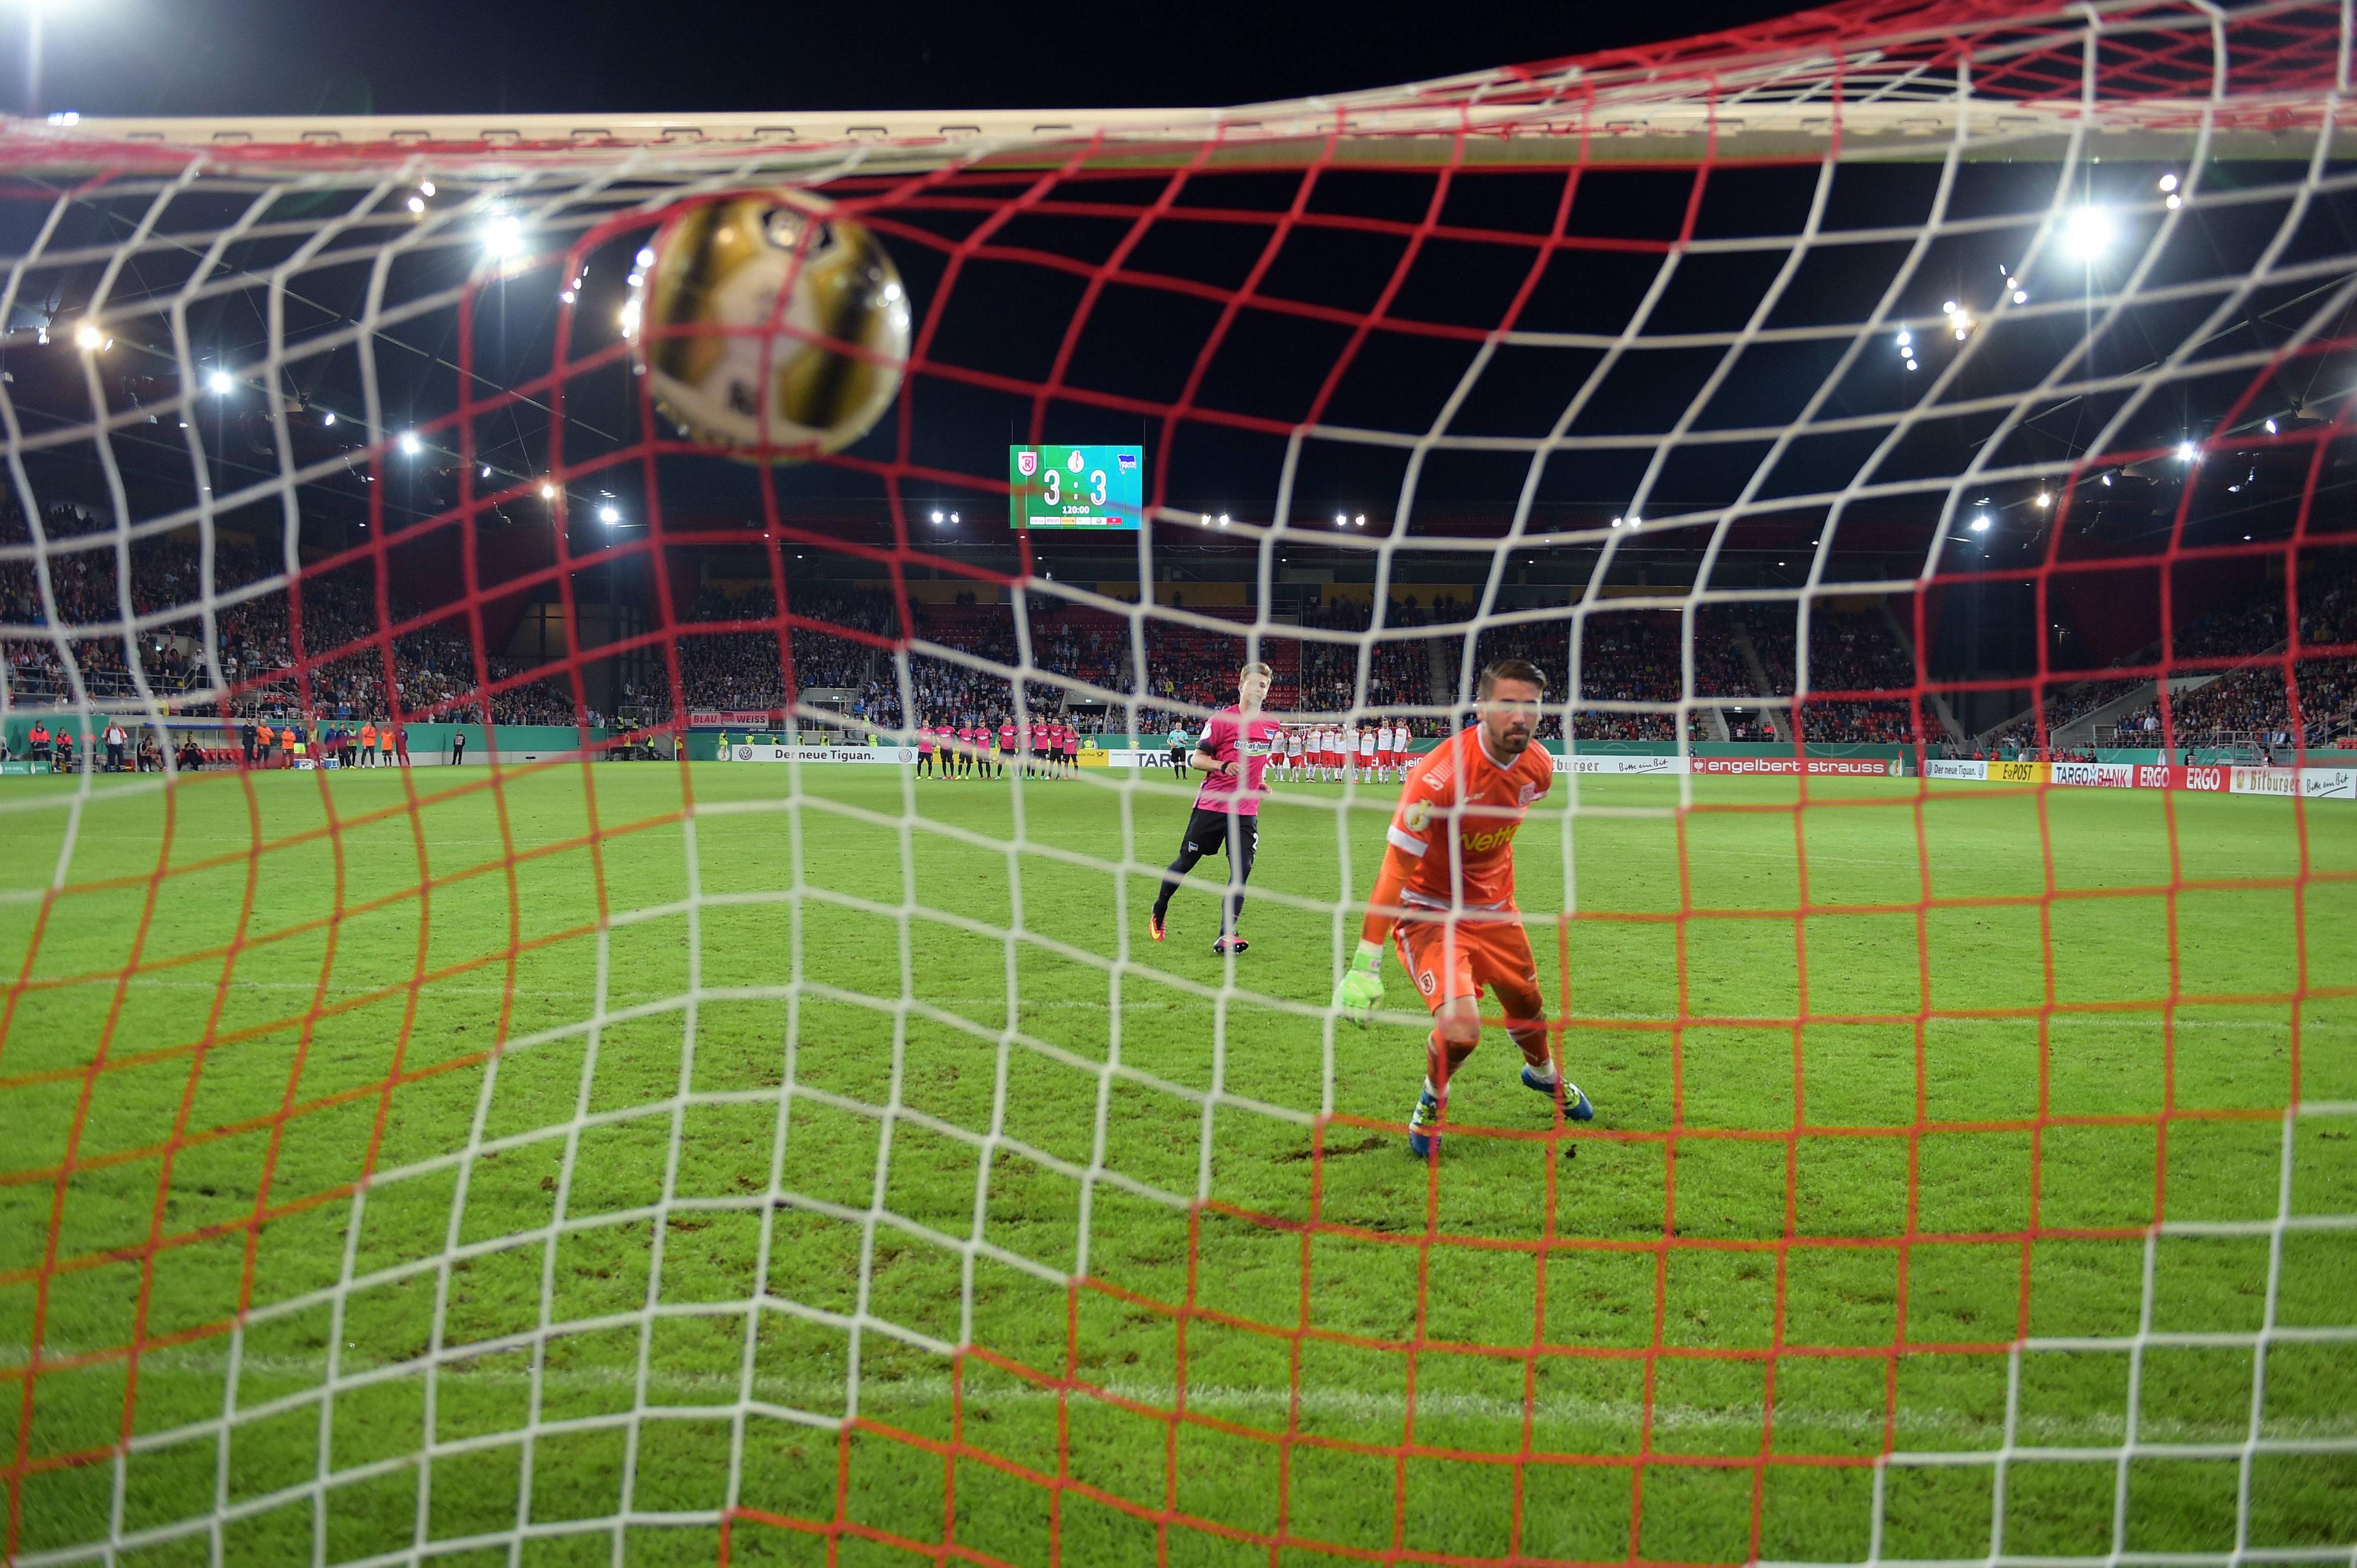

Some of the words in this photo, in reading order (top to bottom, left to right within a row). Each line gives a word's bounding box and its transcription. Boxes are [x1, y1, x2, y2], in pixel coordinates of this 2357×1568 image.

[1044, 470, 1060, 506] 3
[1090, 470, 1107, 506] 3
[1062, 506, 1090, 514] 120:00
[775, 749, 794, 759] Der
[831, 750, 874, 762] Tiguan.
[1619, 762, 1636, 772] Bitte
[1708, 759, 1801, 773] engelbert
[1807, 761, 1884, 773] strauss
[1934, 764, 1944, 774] Der
[1958, 765, 1976, 777] Tiguan.
[2140, 766, 2170, 788] ERGO
[2186, 767, 2221, 790] ERGO
[2250, 770, 2300, 793] Bitburger
[2306, 779, 2320, 793] Bitte
[2323, 779, 2335, 788] ein
[2335, 772, 2349, 786] Bit
